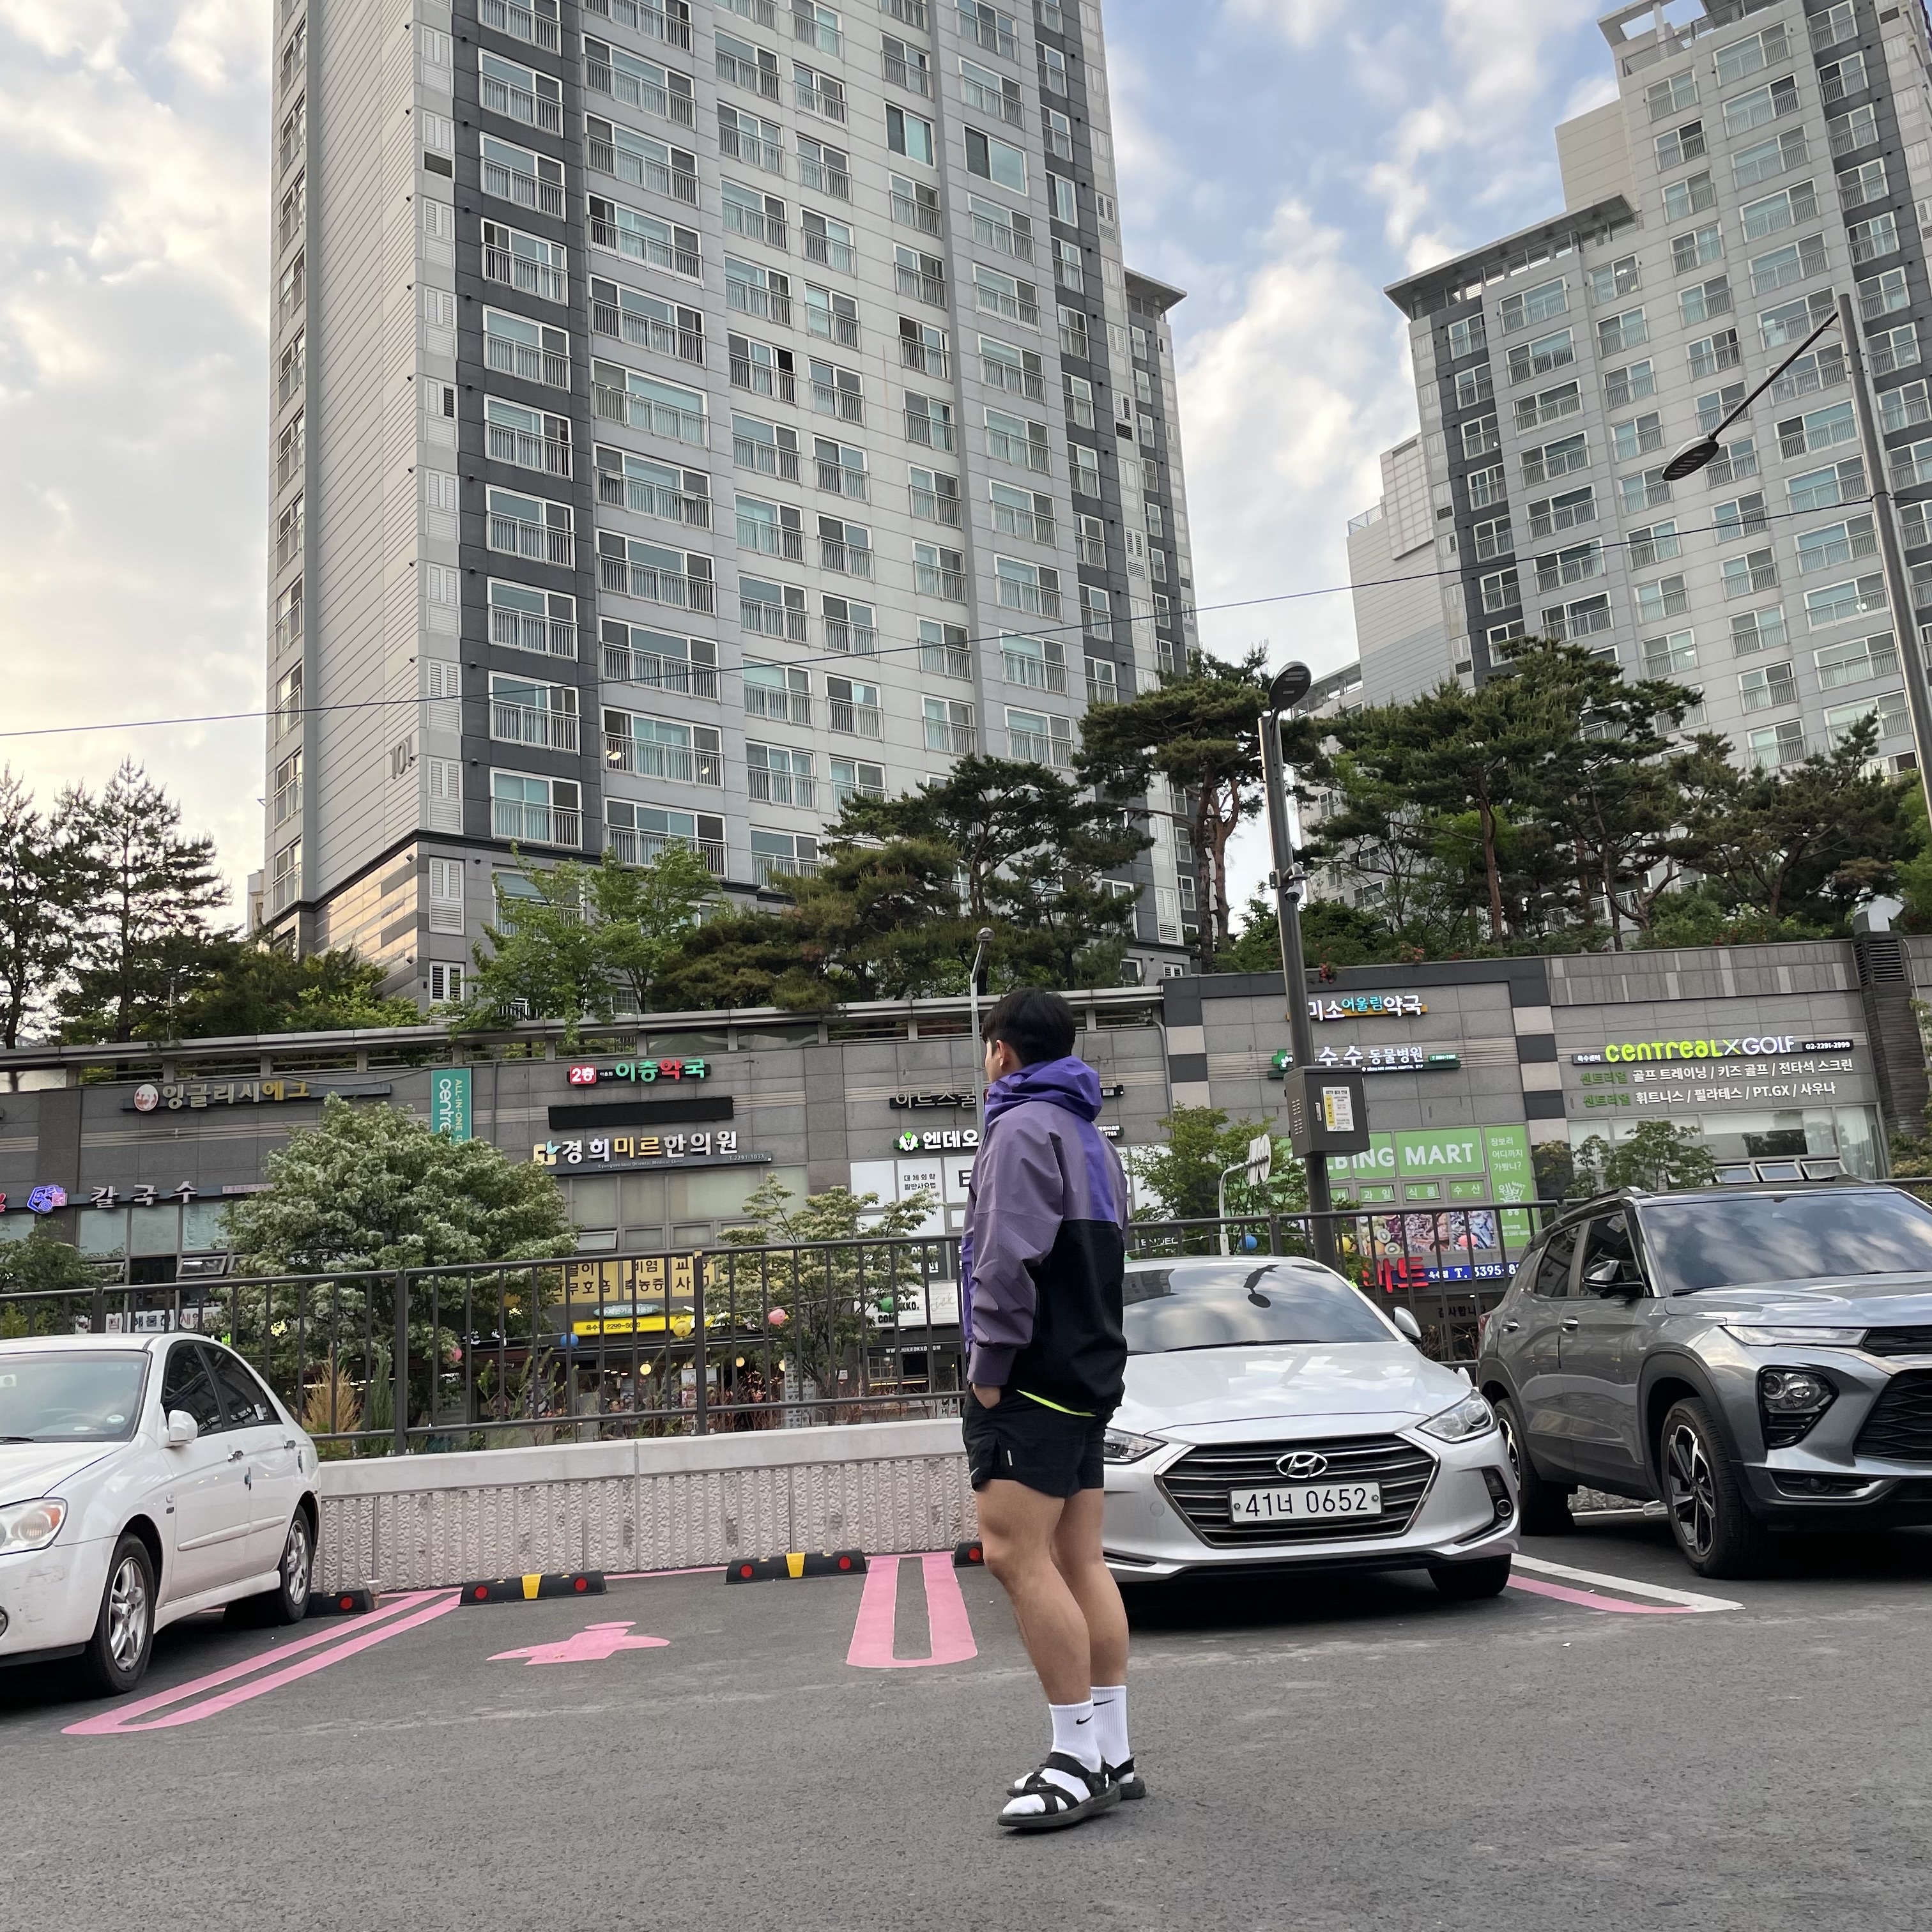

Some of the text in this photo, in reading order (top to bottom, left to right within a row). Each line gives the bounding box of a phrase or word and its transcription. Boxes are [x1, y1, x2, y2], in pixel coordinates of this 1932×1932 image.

[388, 733, 412, 779] 101
[1368, 1046, 1424, 1065] 동물병원
[571, 1066, 595, 1082] 2층
[615, 1059, 705, 1082] 이층약국
[1632, 1069, 1657, 1083] 골프
[1659, 1066, 1707, 1080] 트레이닝
[1717, 1064, 1742, 1078] 키즈
[1744, 1062, 1769, 1077] 골프
[1778, 1060, 1815, 1075] 전타석
[1818, 1058, 1853, 1072] 스크린
[162, 1080, 310, 1110] 잉글리시에그
[1635, 1090, 1685, 1105] 휘트니스
[1694, 1087, 1743, 1102] 필라테스
[1752, 1084, 1790, 1098] PT.GX
[1800, 1081, 1836, 1096] 사우나
[562, 1131, 737, 1164] 경희미르한의원
[1406, 1142, 1474, 1167] MART
[1492, 1149, 1523, 1159] 어디까지
[1453, 1183, 1480, 1195] 수산
[1246, 1487, 1368, 1516] 41너 0652
